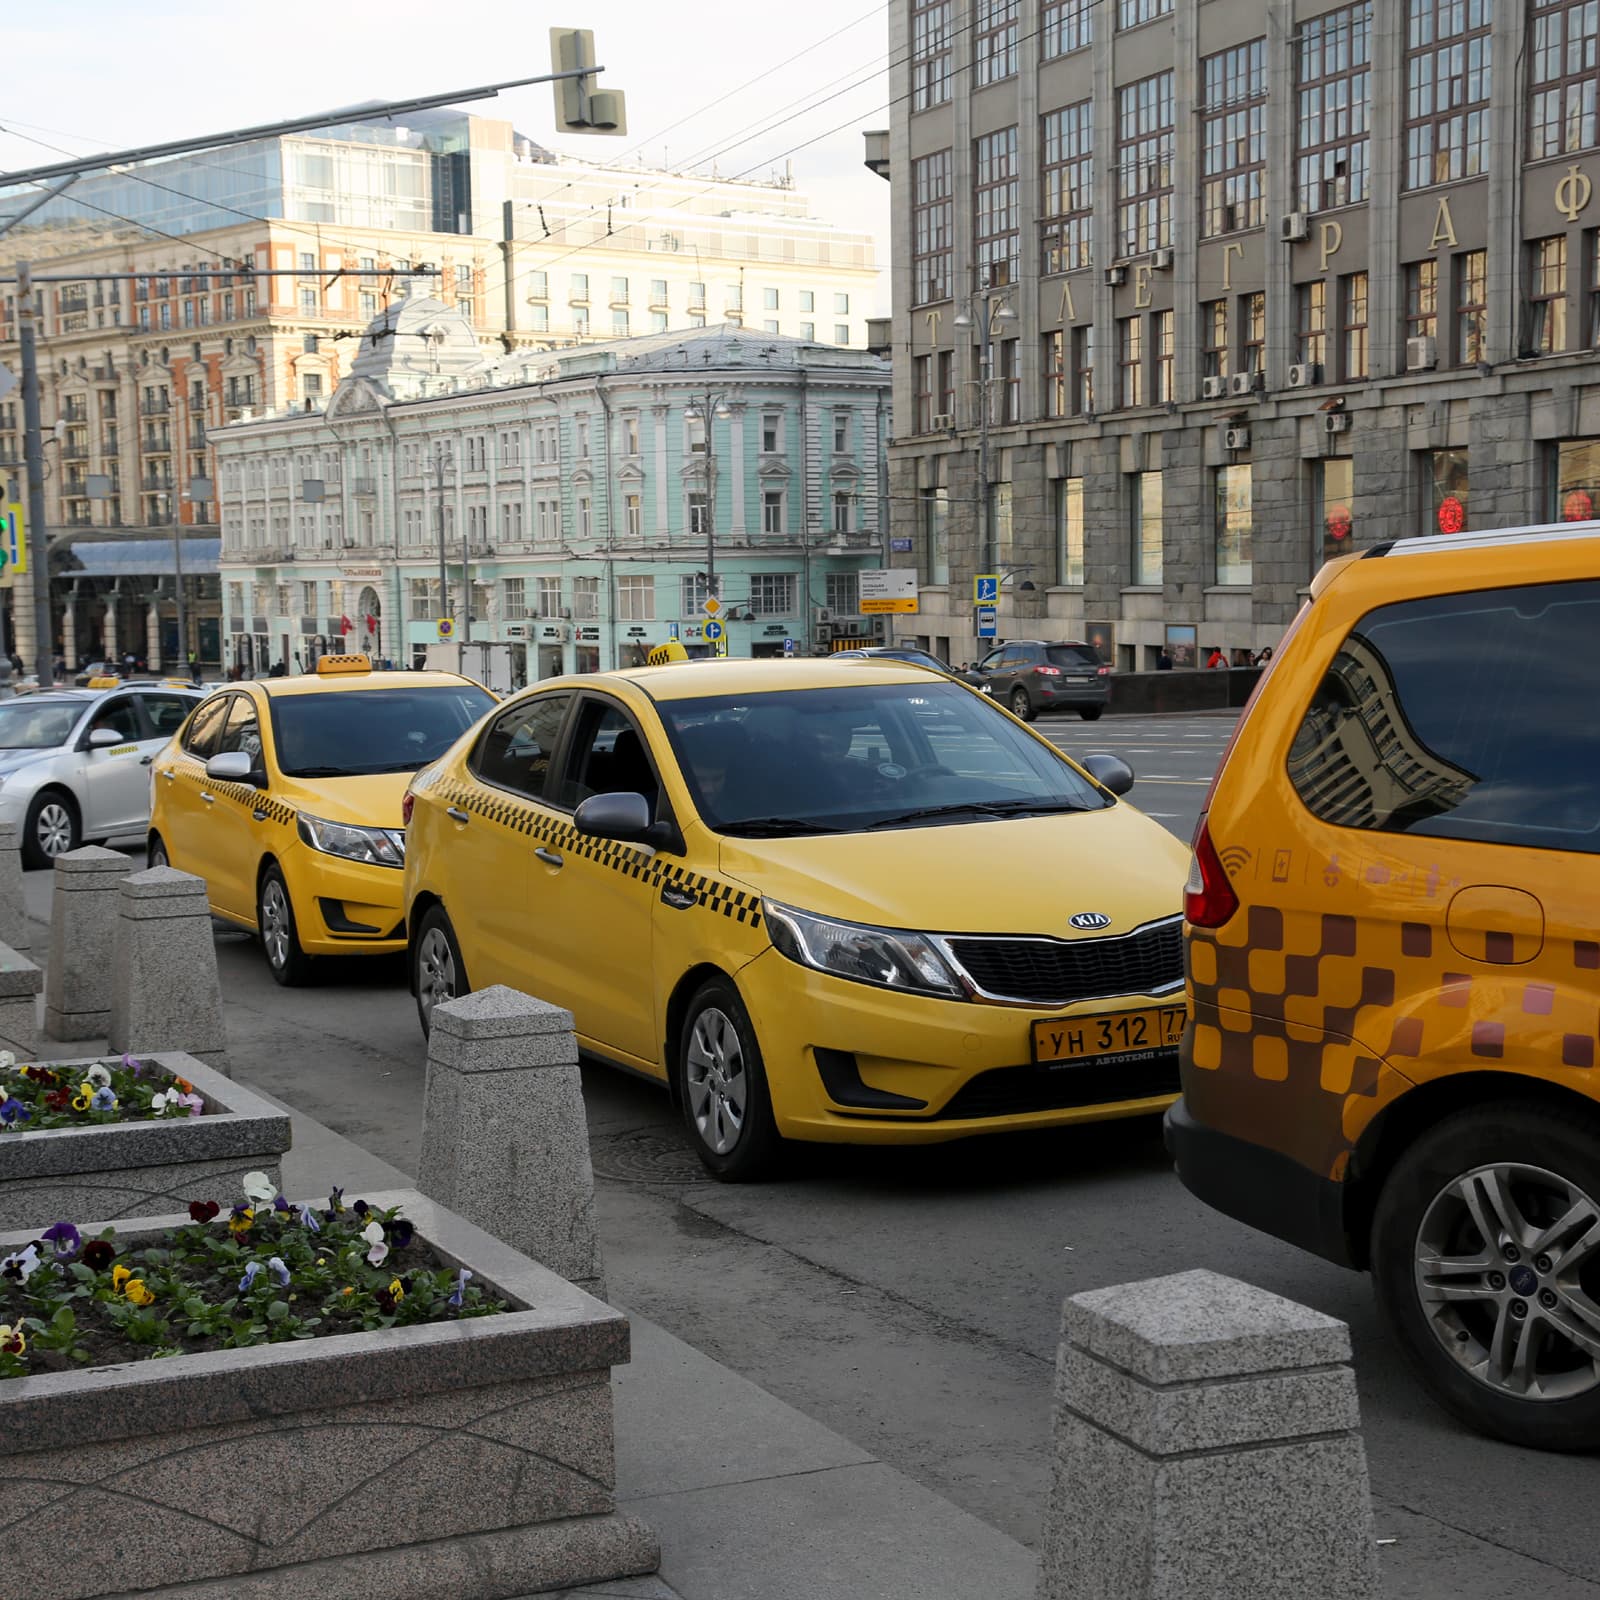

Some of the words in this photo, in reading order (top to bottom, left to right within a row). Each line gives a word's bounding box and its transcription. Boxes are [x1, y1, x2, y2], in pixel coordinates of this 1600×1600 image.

[925, 164, 1593, 348] ТЕЛЕГРАФ
[1075, 913, 1107, 926] KIA
[1050, 1029, 1084, 1055] УН
[1096, 1016, 1148, 1049] 312
[1163, 1009, 1187, 1033] 77
